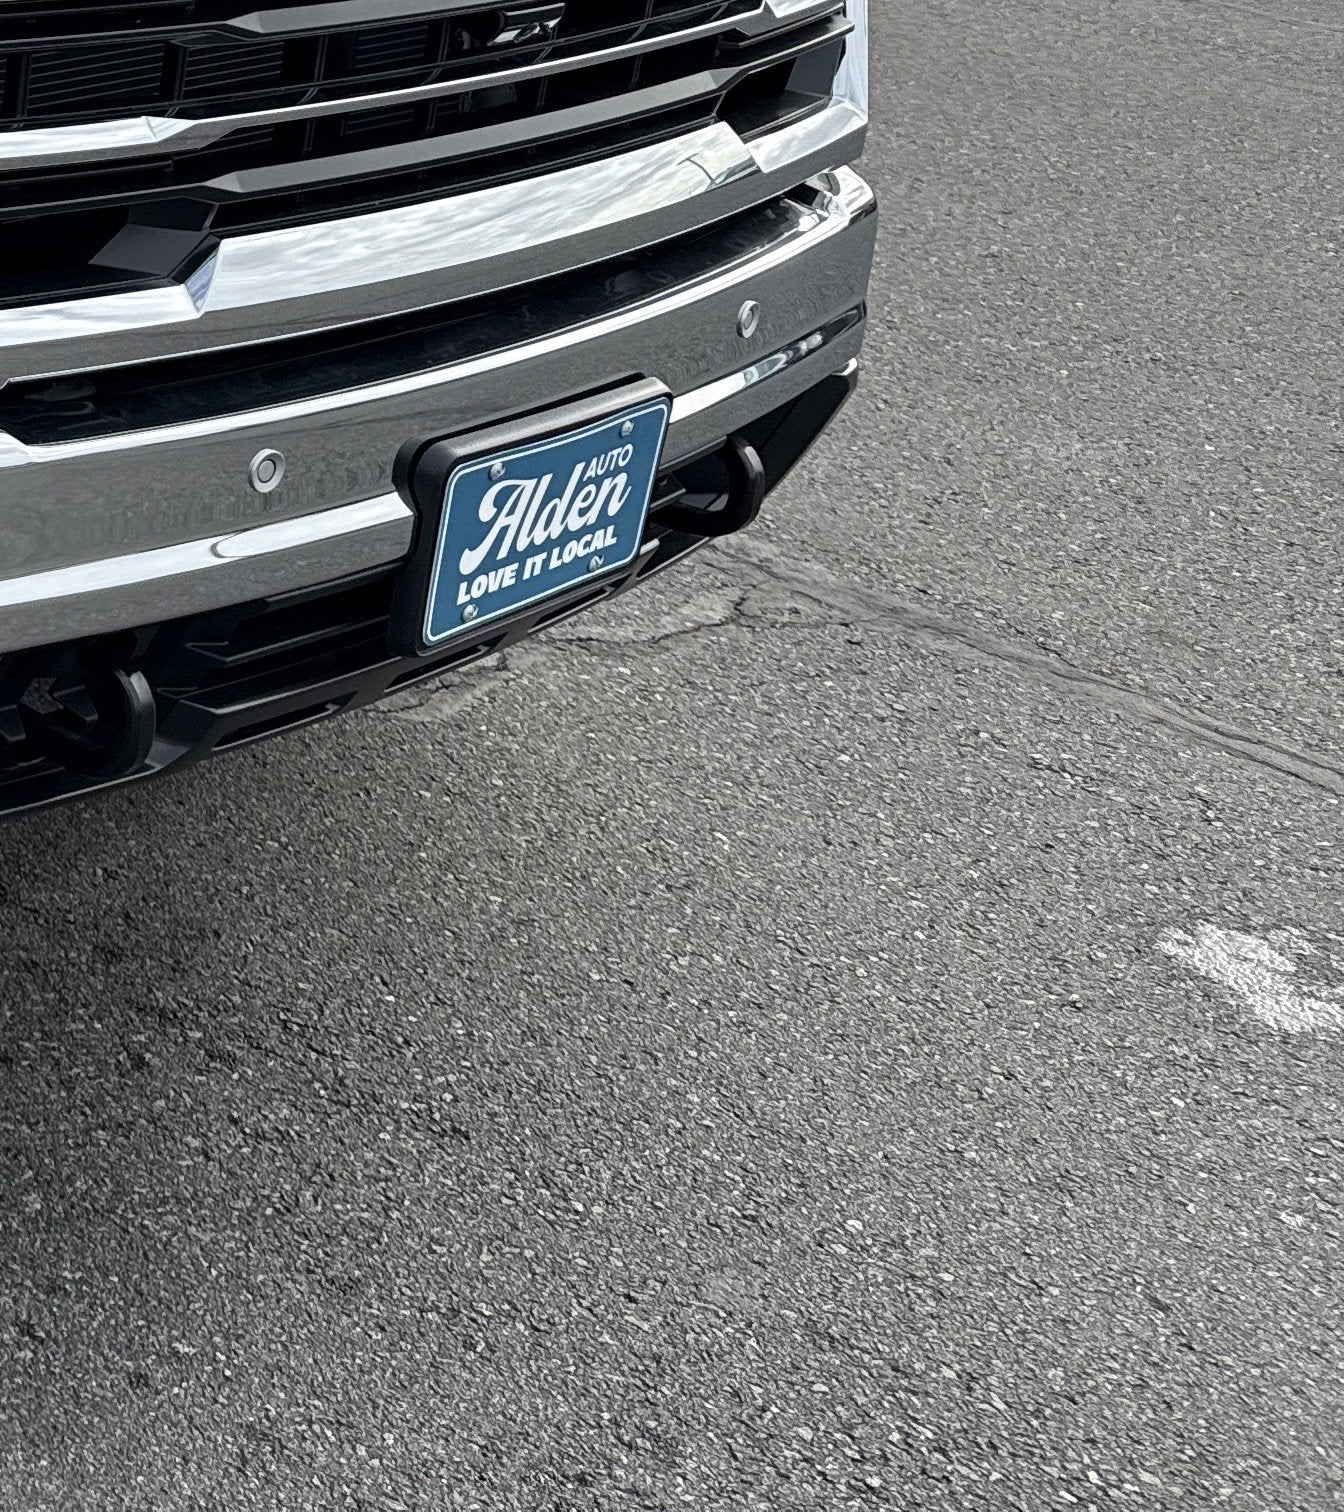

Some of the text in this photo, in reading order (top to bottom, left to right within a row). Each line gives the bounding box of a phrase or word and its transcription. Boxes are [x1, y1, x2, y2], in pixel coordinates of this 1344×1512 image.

[583, 443, 633, 481] AUTO
[459, 458, 632, 575] Alden
[456, 525, 617, 605] LOVE IT LOCAL
